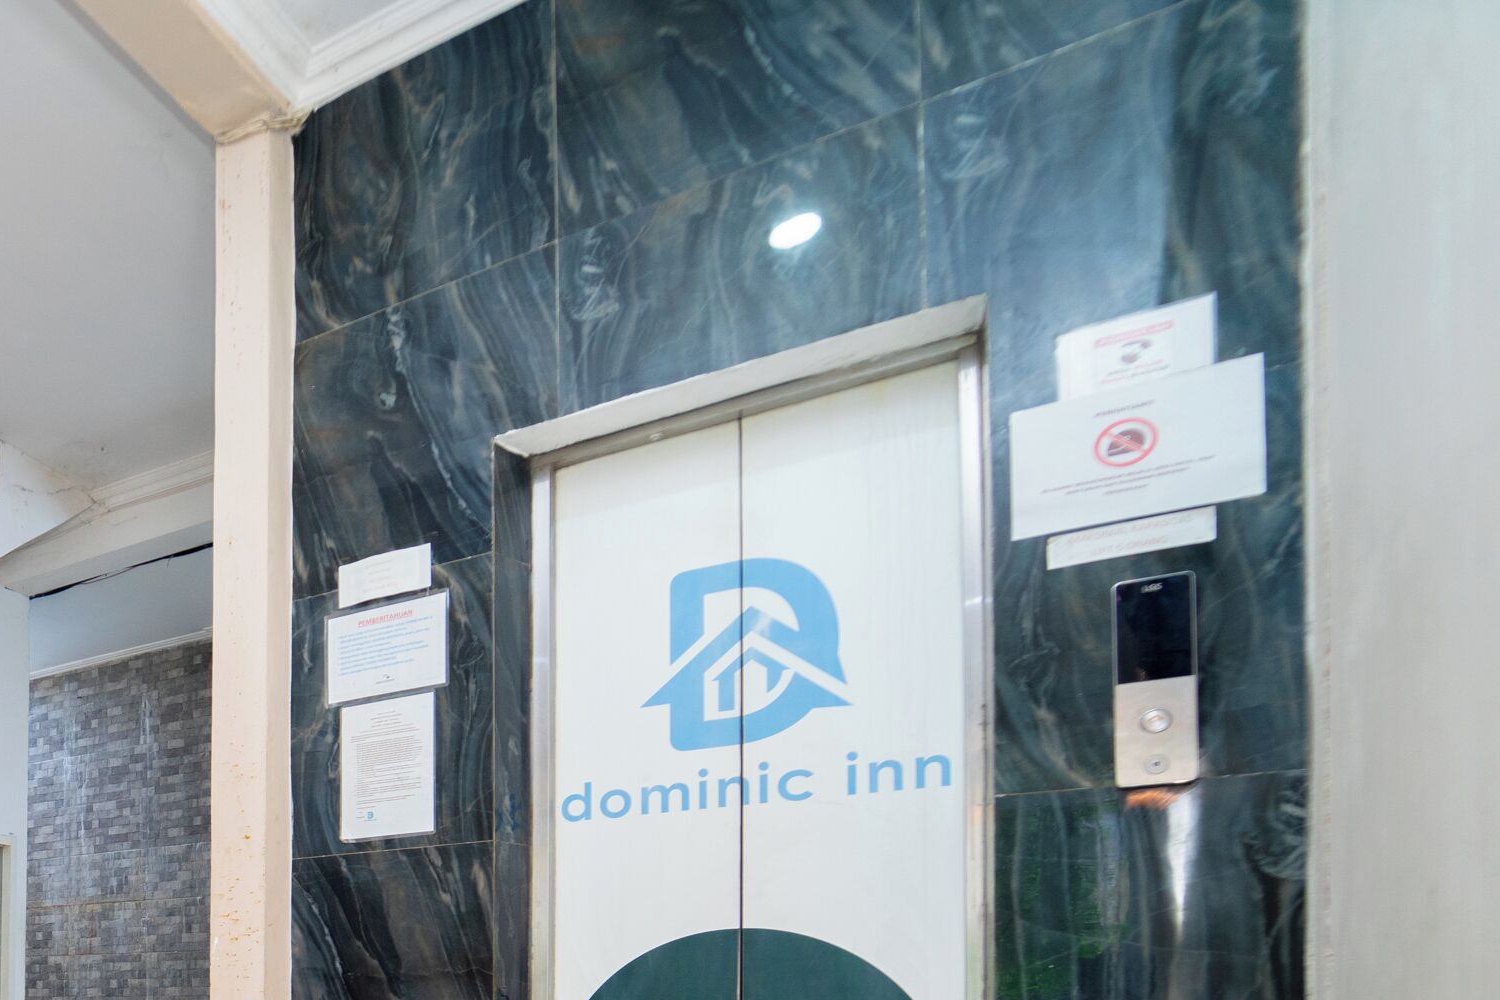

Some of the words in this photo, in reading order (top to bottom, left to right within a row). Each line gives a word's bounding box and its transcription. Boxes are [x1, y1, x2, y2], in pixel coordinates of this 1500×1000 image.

[357, 609, 414, 628] PEMBERITAHUAN
[561, 761, 815, 822] dominic
[846, 751, 953, 796] inn
